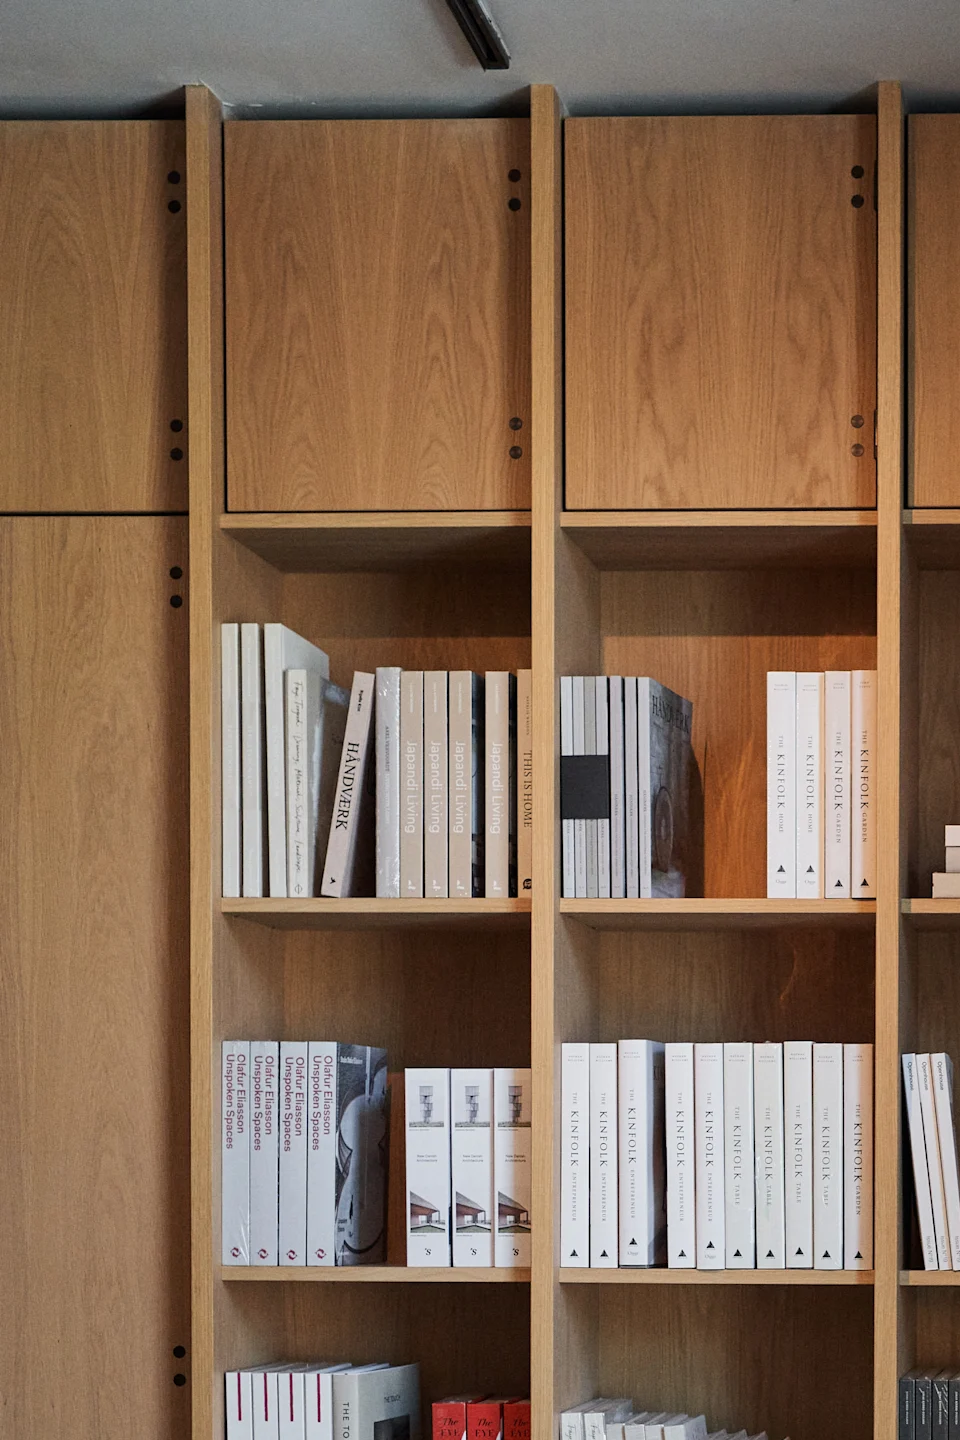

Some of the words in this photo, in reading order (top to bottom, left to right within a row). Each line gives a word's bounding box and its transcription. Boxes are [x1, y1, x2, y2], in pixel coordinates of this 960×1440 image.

[334, 741, 361, 831] HÅNDVÆRK
[405, 740, 418, 791] Japandi
[430, 740, 442, 791] Japandi
[454, 740, 467, 791] Japandi
[491, 742, 504, 791] Japandi
[523, 750, 532, 778] THIS
[523, 780, 532, 790] IS
[777, 754, 786, 808] KINFOLK
[806, 754, 815, 808] KINFOLK
[834, 750, 844, 811] KINFOLK
[860, 748, 870, 810] KINFOLK
[404, 795, 418, 834] Living
[428, 795, 442, 834] Living
[452, 795, 467, 834] Living
[490, 796, 504, 835] Living
[523, 792, 532, 828] HOME
[224, 1054, 235, 1108] Unspoken
[236, 1054, 246, 1087] Olafur
[252, 1056, 263, 1109] Unspoken
[264, 1056, 275, 1088] Olafur
[282, 1056, 294, 1110] Unspoken
[295, 1056, 305, 1089] Olafur
[311, 1055, 322, 1108] Unspoken
[323, 1055, 333, 1087] Olafur
[936, 1061, 944, 1091] Openhouse
[224, 1110, 235, 1150] Spaces
[236, 1089, 246, 1134] Eliasson
[252, 1111, 263, 1151] Spaces
[264, 1090, 275, 1135] Eliasson
[282, 1112, 294, 1152] Spaces
[295, 1092, 305, 1136] Eliasson
[311, 1110, 322, 1150] Spaces
[323, 1090, 333, 1135] Eliasson
[599, 1110, 609, 1167] KINFOLK
[676, 1110, 686, 1168] KINFOLK
[704, 1110, 714, 1168] KINFOLK
[732, 1125, 742, 1180] KINFOLK
[794, 1123, 804, 1178] KINFOLK
[853, 1122, 863, 1182] KINFOLK
